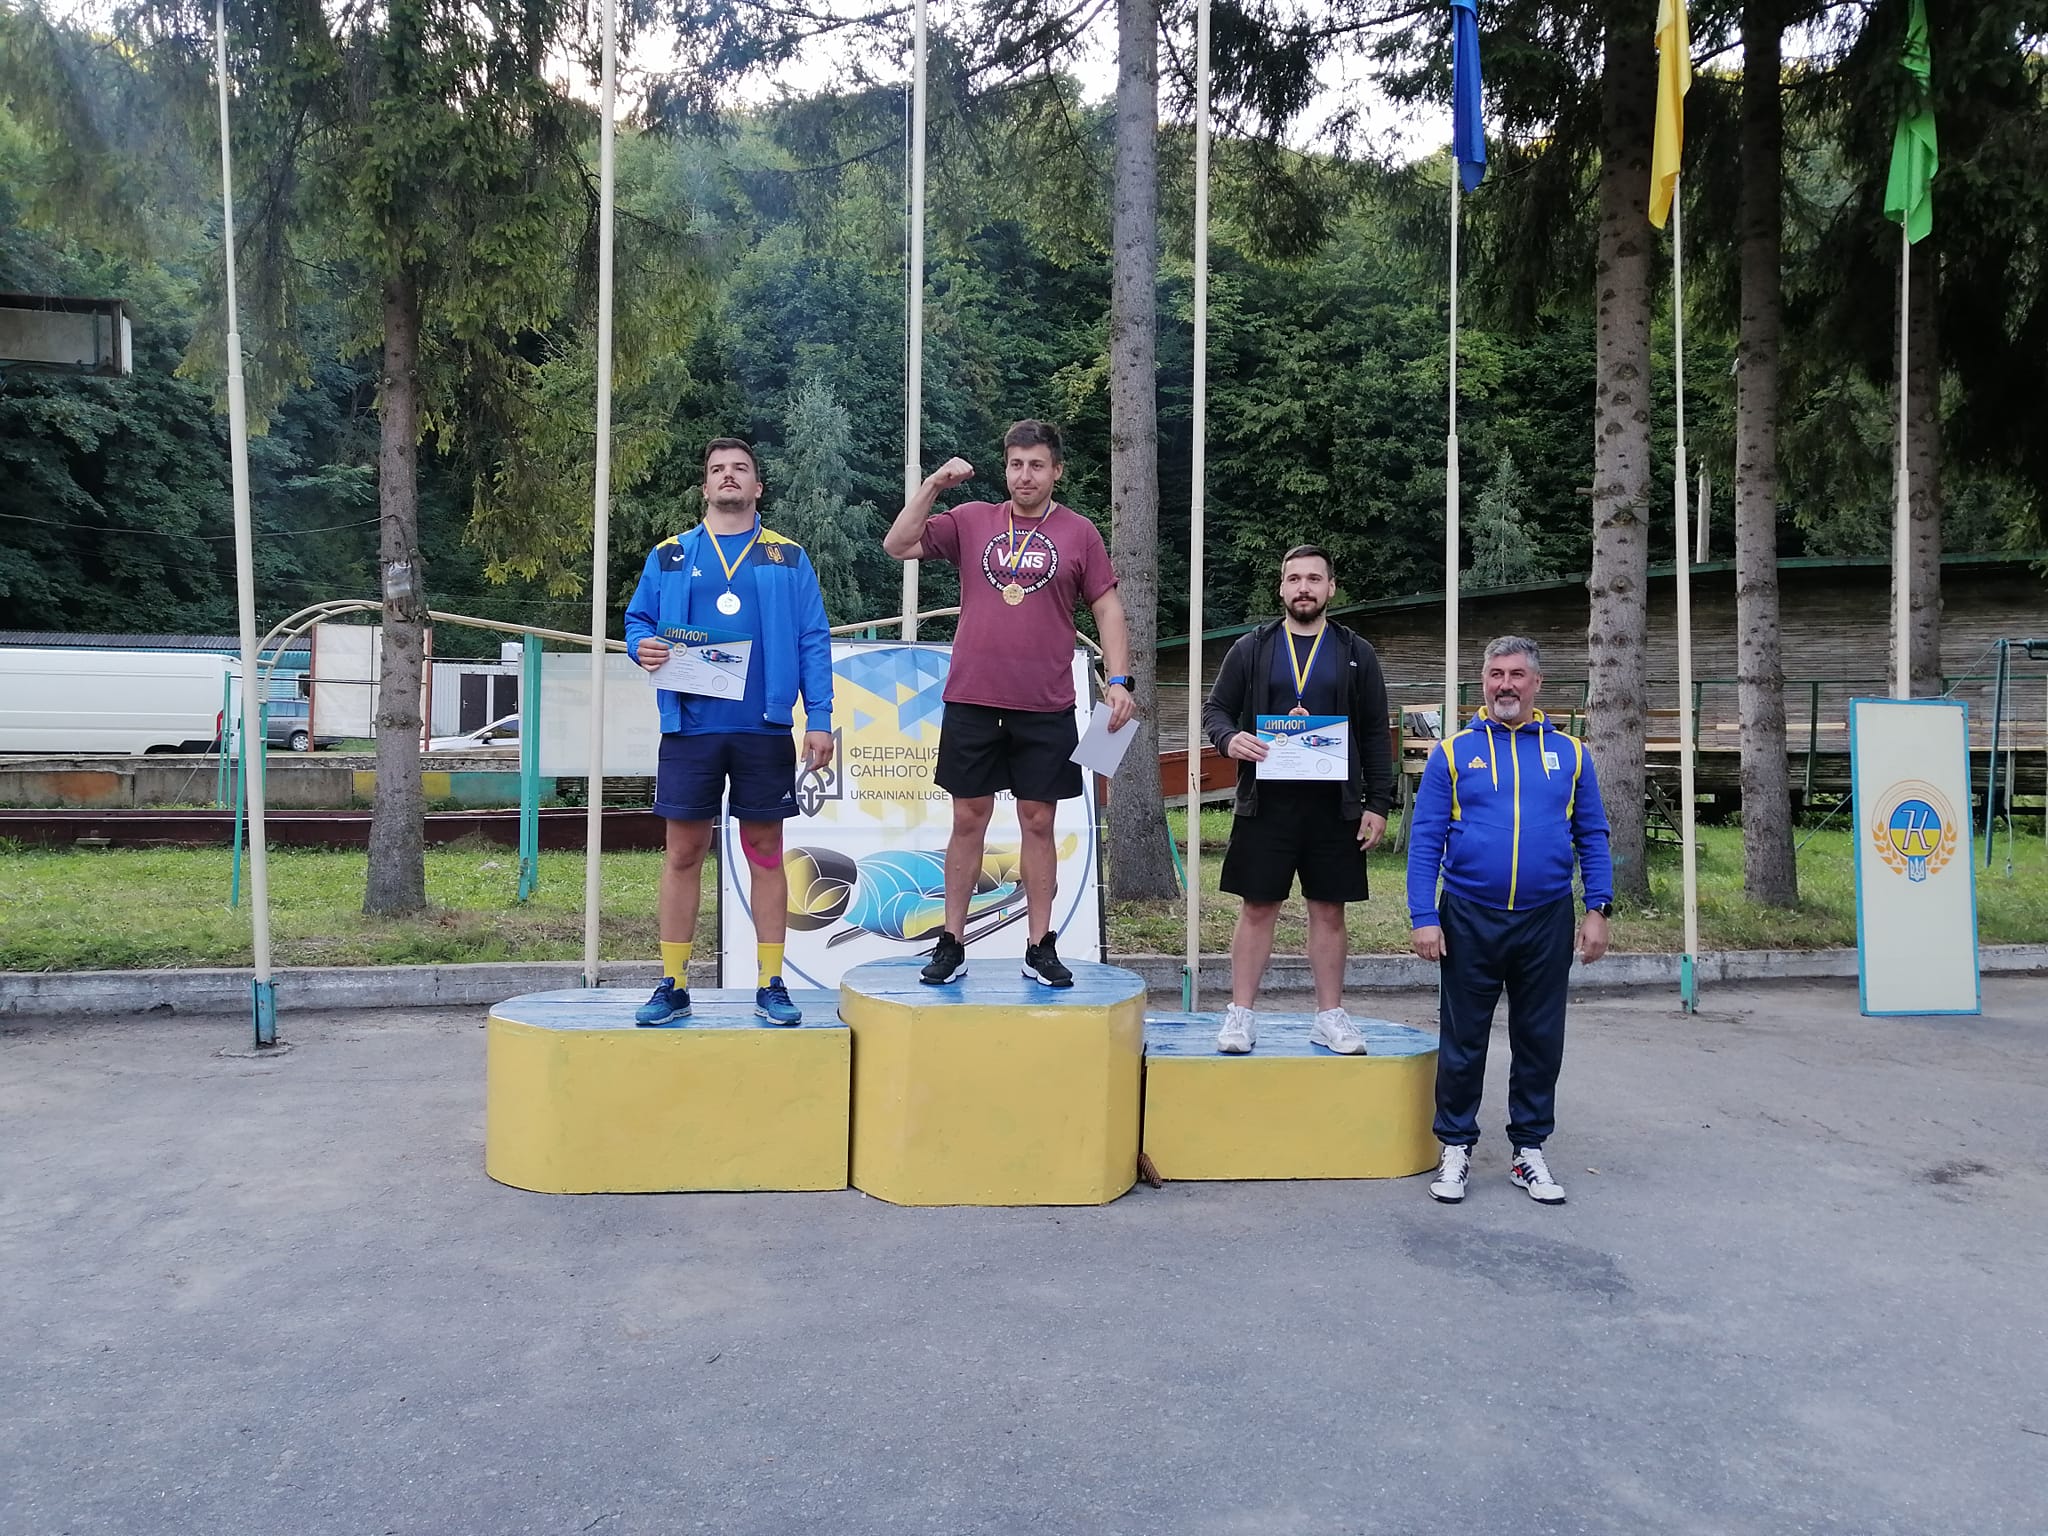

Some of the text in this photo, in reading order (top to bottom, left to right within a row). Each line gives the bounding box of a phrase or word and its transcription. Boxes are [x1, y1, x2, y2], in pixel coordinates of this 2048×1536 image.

[664, 627, 708, 642] ДИПЛОМ
[1264, 719, 1306, 730] ДИПЛОМ
[850, 746, 940, 763] ФЕДЕРАЦІЯ
[850, 764, 929, 778] САННОГО
[850, 790, 950, 801] UKRAINIAN LUGE
